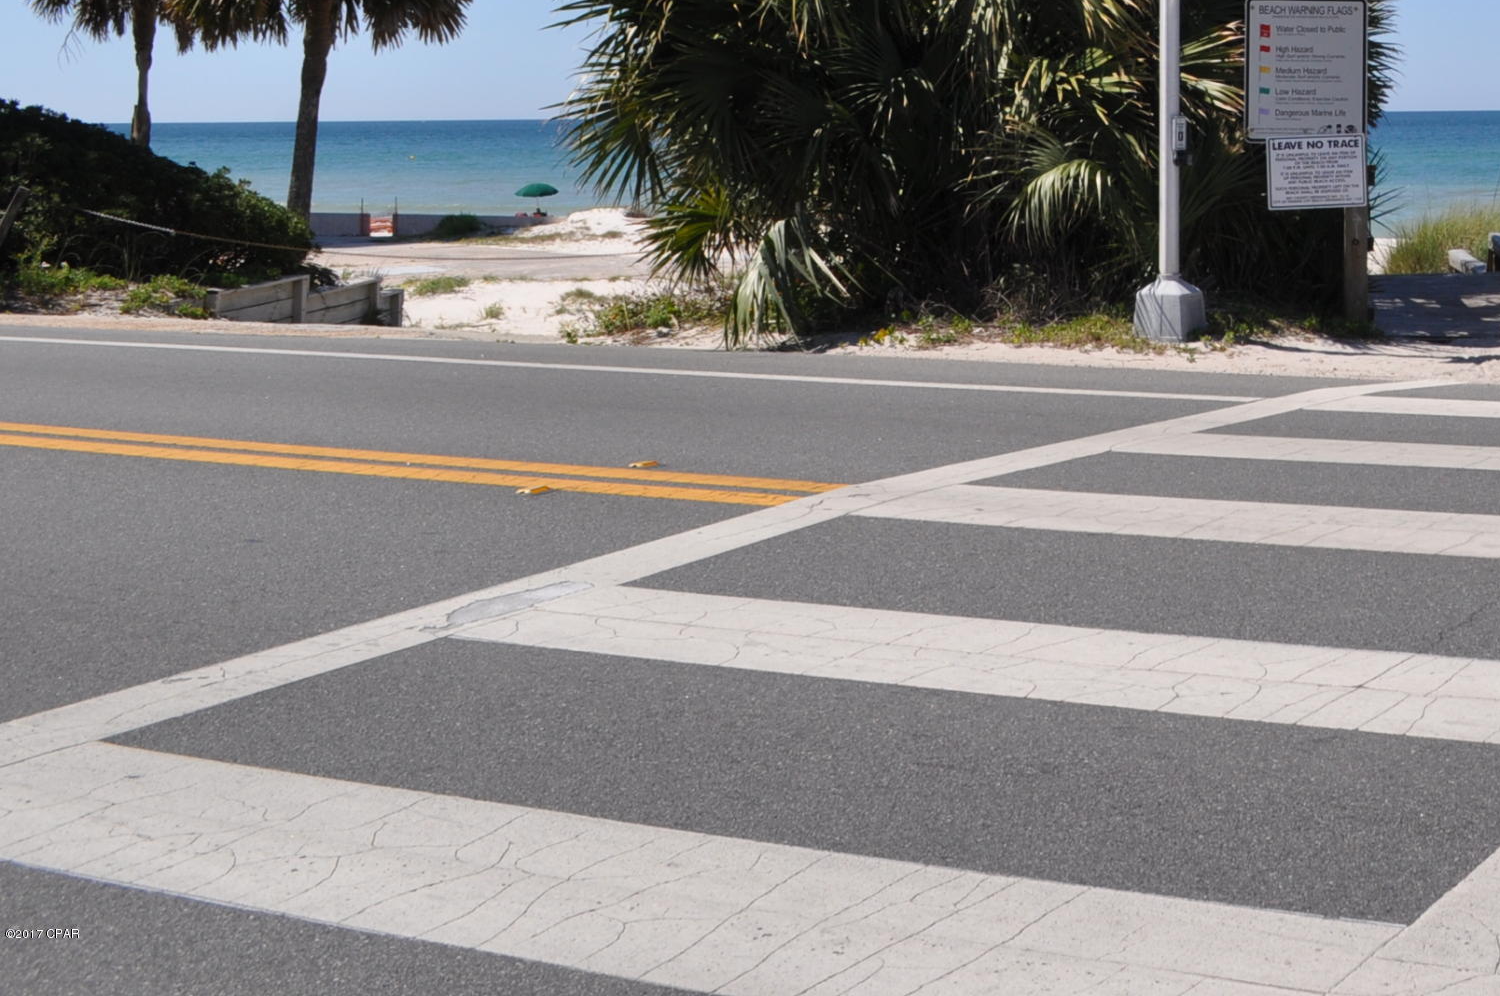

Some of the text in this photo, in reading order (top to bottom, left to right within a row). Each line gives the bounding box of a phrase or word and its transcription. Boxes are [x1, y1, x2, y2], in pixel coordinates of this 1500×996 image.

[1259, 5, 1353, 15] BEACH WARNING FLAGS
[1296, 25, 1318, 33] Closed
[1275, 109, 1310, 117] Dangerous
[1272, 139, 1359, 150] LEAVE NO TRACE
